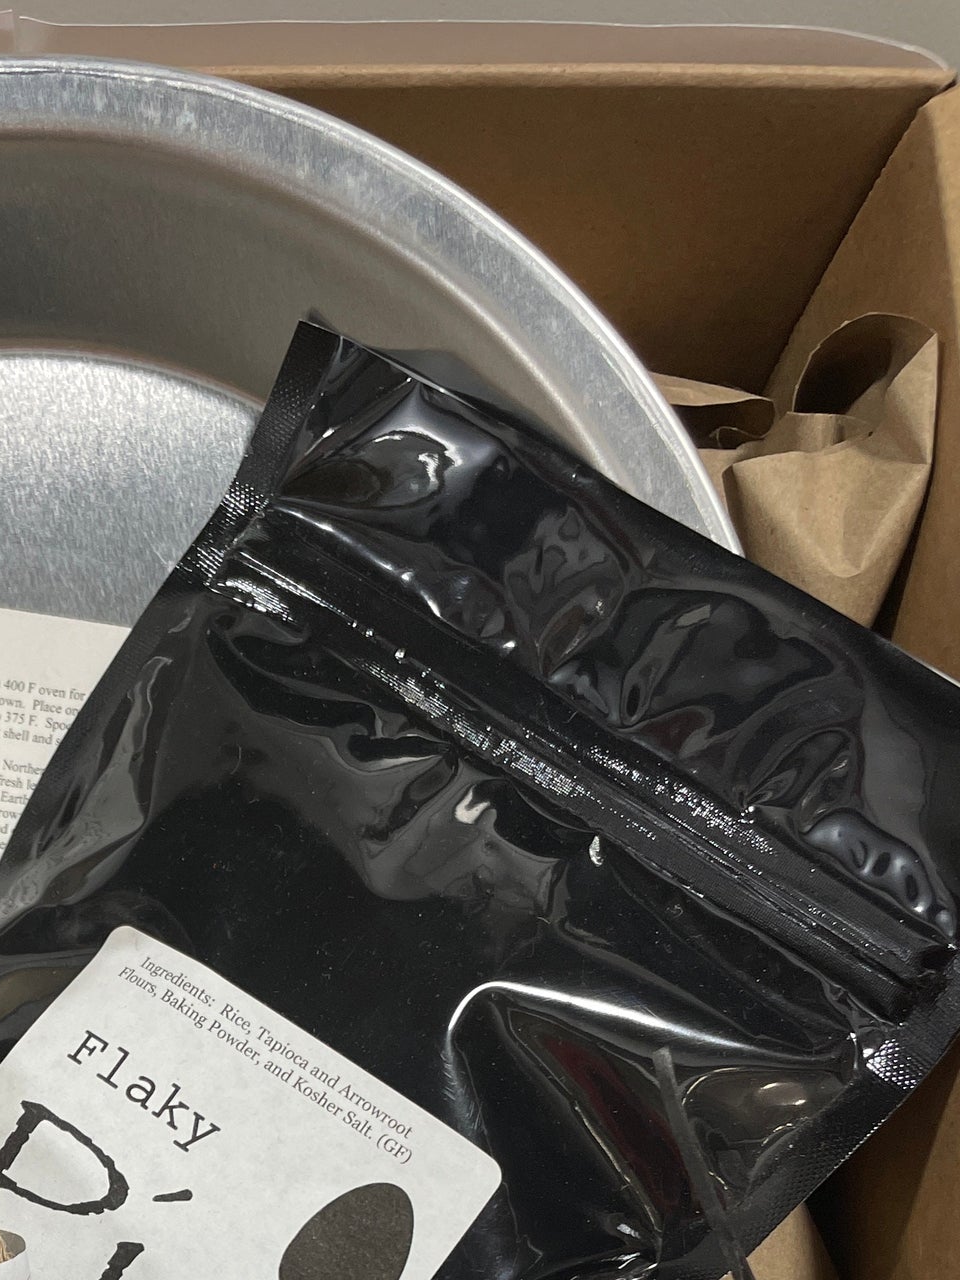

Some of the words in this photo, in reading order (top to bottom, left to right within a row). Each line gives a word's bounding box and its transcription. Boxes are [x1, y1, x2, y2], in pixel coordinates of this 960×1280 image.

[3, 680, 25, 691] 400
[28, 682, 37, 693] F
[38, 686, 66, 698] oven
[66, 1030, 221, 1152] Flaky
[118, 966, 158, 998] Flours,
[160, 990, 207, 1029] Baking
[207, 1020, 261, 1065] Powder,
[263, 1058, 293, 1085] and
[291, 1074, 344, 1117] Kosher
[342, 1110, 374, 1141] Salt.
[376, 1132, 413, 1165] (GF)
[140, 957, 215, 1009] Ingredients:
[219, 1002, 252, 1035] Rice,
[258, 1026, 309, 1071] Tapioca
[309, 1060, 341, 1090] and
[340, 1083, 414, 1139] Arrowroot
